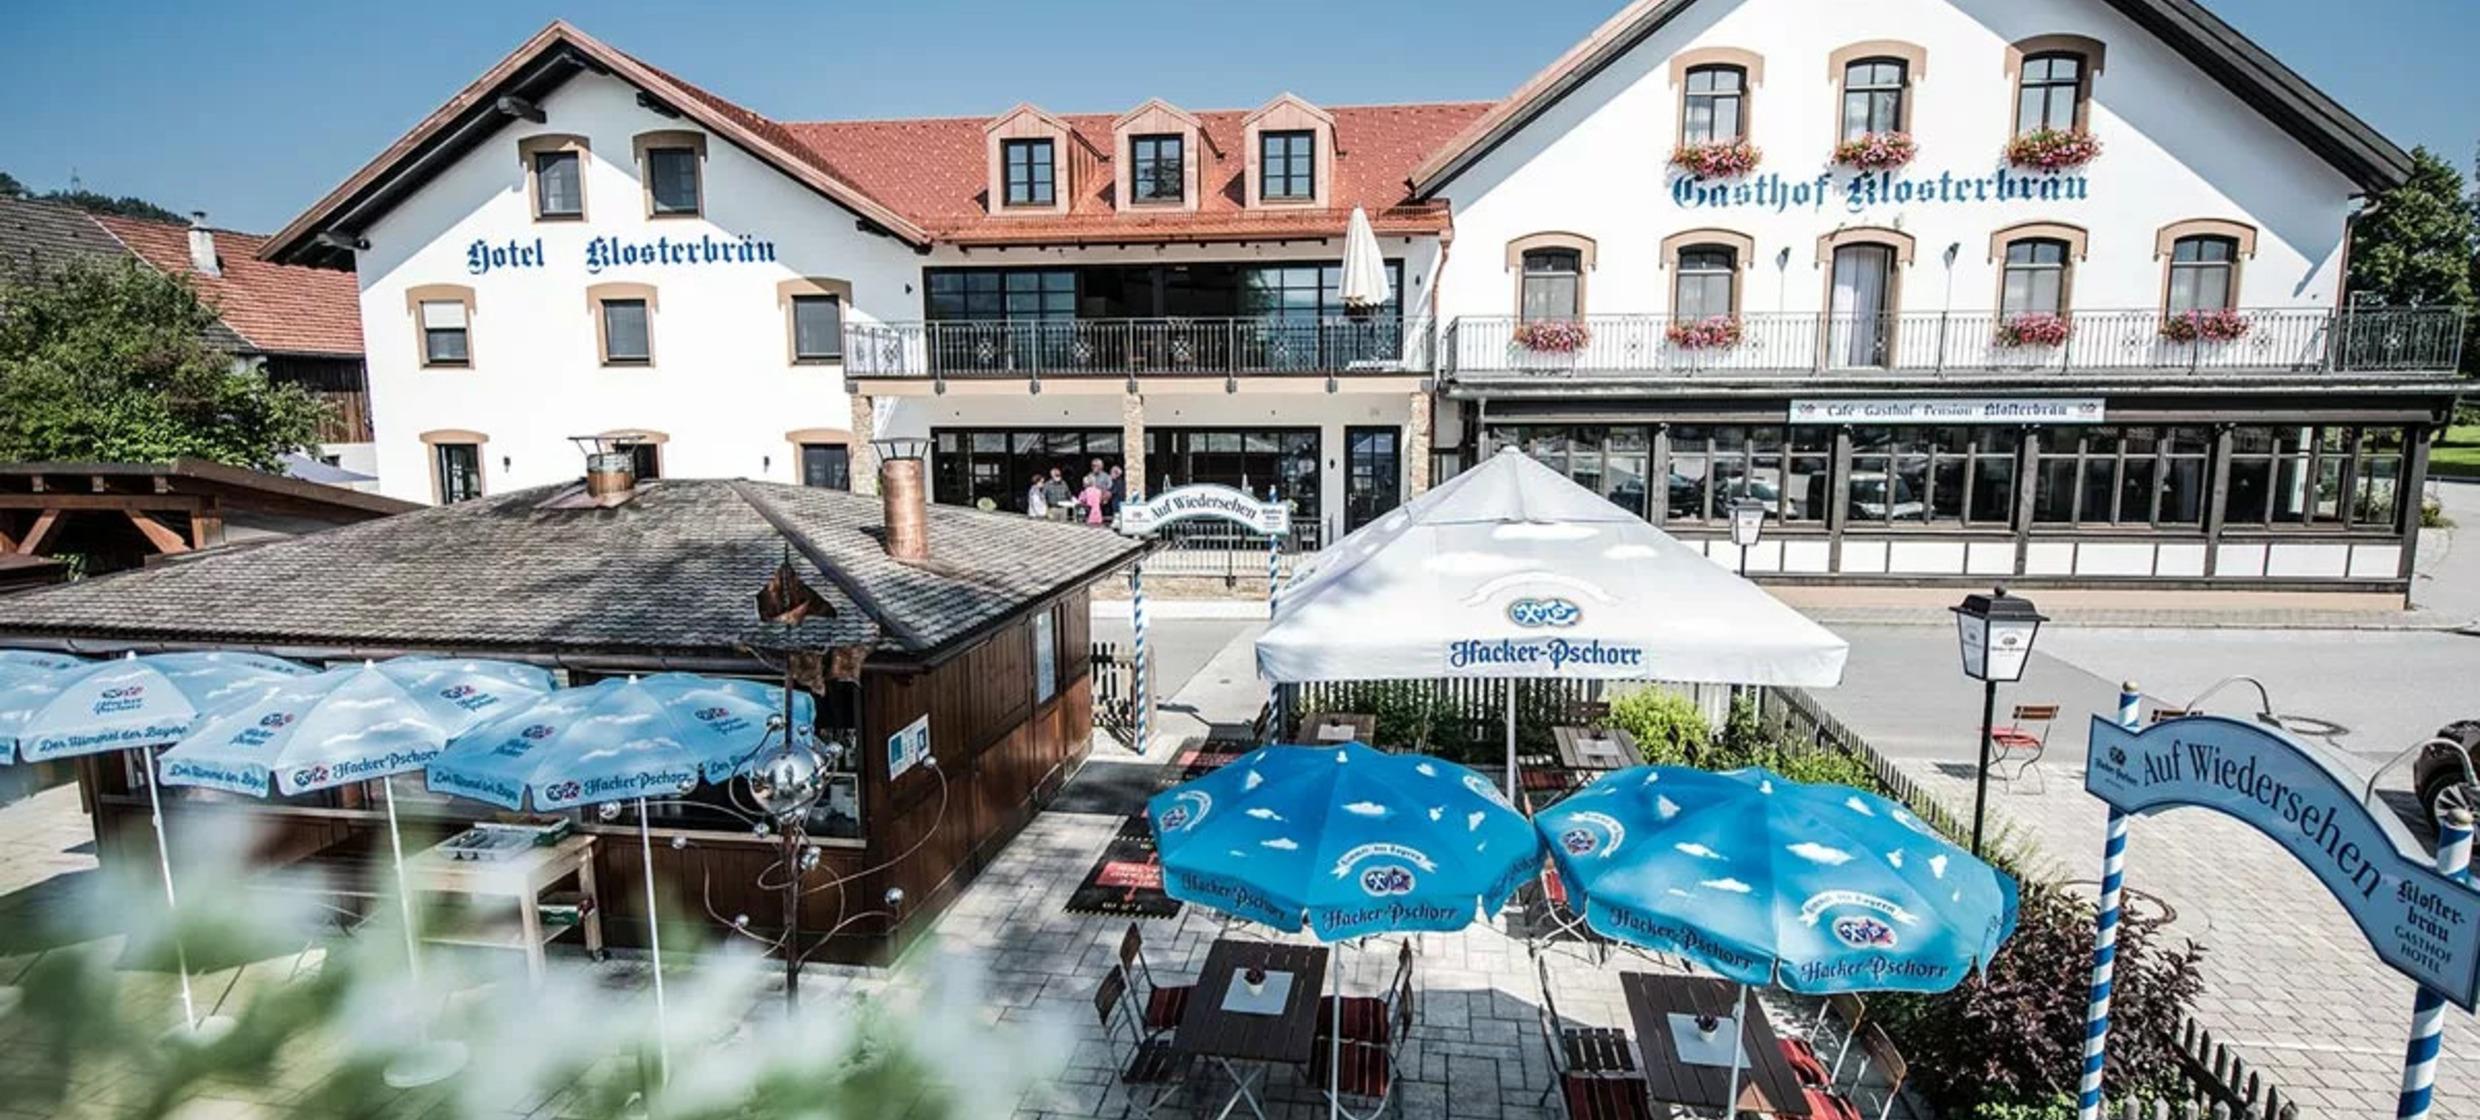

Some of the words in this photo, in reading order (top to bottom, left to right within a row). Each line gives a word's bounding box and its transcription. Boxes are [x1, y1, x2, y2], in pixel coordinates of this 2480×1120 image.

[1672, 173, 1832, 213] Gasthof
[1846, 169, 2088, 213] Klosterbräu
[467, 237, 544, 275] Hotel
[586, 235, 776, 274] Klosterbräu
[1864, 403, 1913, 417] Gasthof
[1923, 404, 1973, 416] Pension
[1150, 504, 1172, 521] Auf
[1173, 493, 1258, 520] Wiedersehen
[1450, 638, 1642, 670] Hacker-Pschorr
[2143, 740, 2182, 787] Auf
[2187, 742, 2383, 900] Wiedersehen
[1322, 901, 1457, 933] Hacker-Pschorr
[1609, 905, 1755, 970] Hacker-Pschorr
[2394, 925, 2452, 964] GASTHOF
[1802, 955, 1949, 982] Hacker-Pschorr
[2401, 943, 2441, 973] HOTEL
